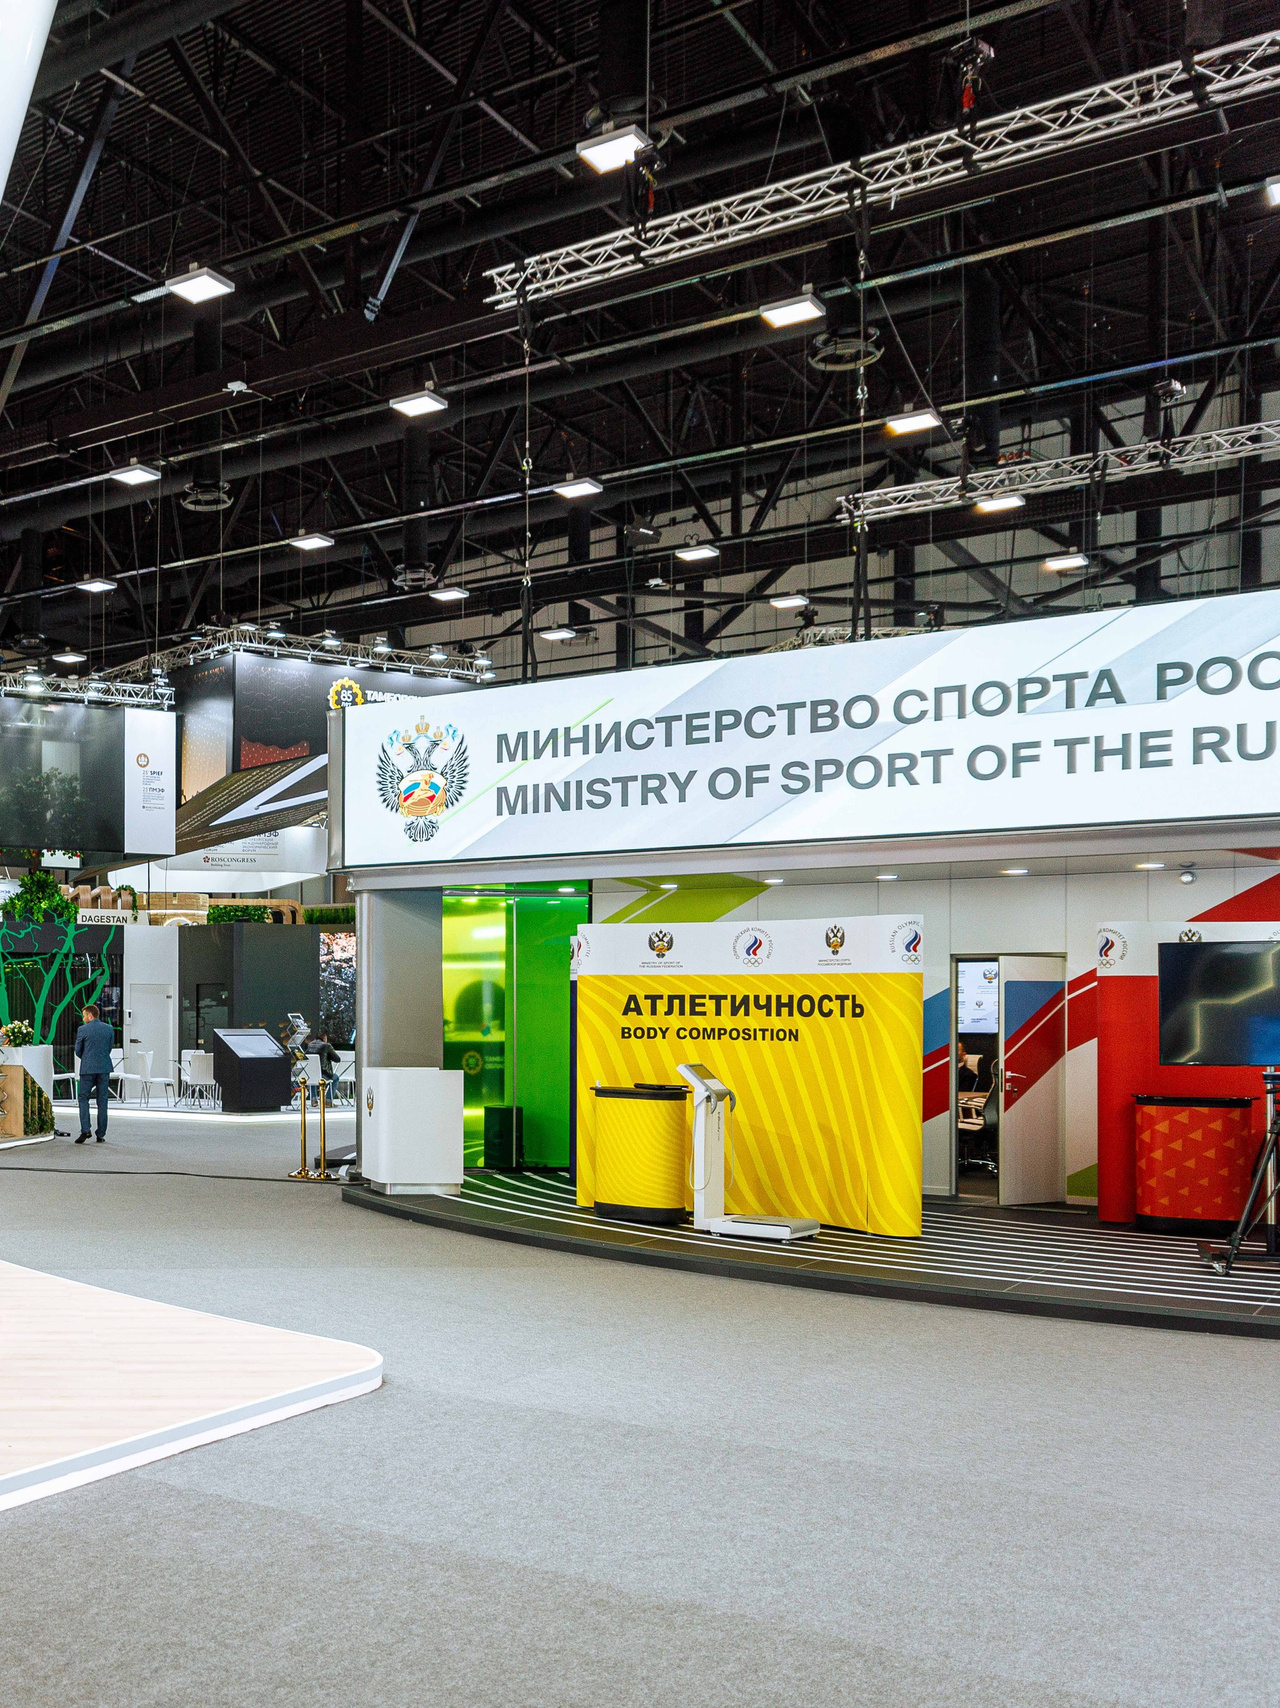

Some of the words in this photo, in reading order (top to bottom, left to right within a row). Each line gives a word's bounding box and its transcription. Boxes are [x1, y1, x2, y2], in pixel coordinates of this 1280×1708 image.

[340, 689, 353, 702] 85
[496, 694, 880, 764] МИНИСТЕРСТВО
[893, 668, 1127, 725] СПОРТА
[1156, 650, 1280, 701] РОС
[496, 770, 698, 817] MINISTRY
[708, 763, 770, 801] OF
[781, 748, 954, 795] SPORT
[966, 740, 1041, 781] OF
[1054, 729, 1173, 775] THE
[1192, 720, 1277, 765] RU
[81, 914, 128, 924] DAGESTAN
[889, 929, 898, 954] RUSSIAN
[622, 994, 865, 1019] АТЛЕТИЧНОСТЬ
[621, 1026, 668, 1040] BODY
[676, 1027, 799, 1042] COMPOSITION
